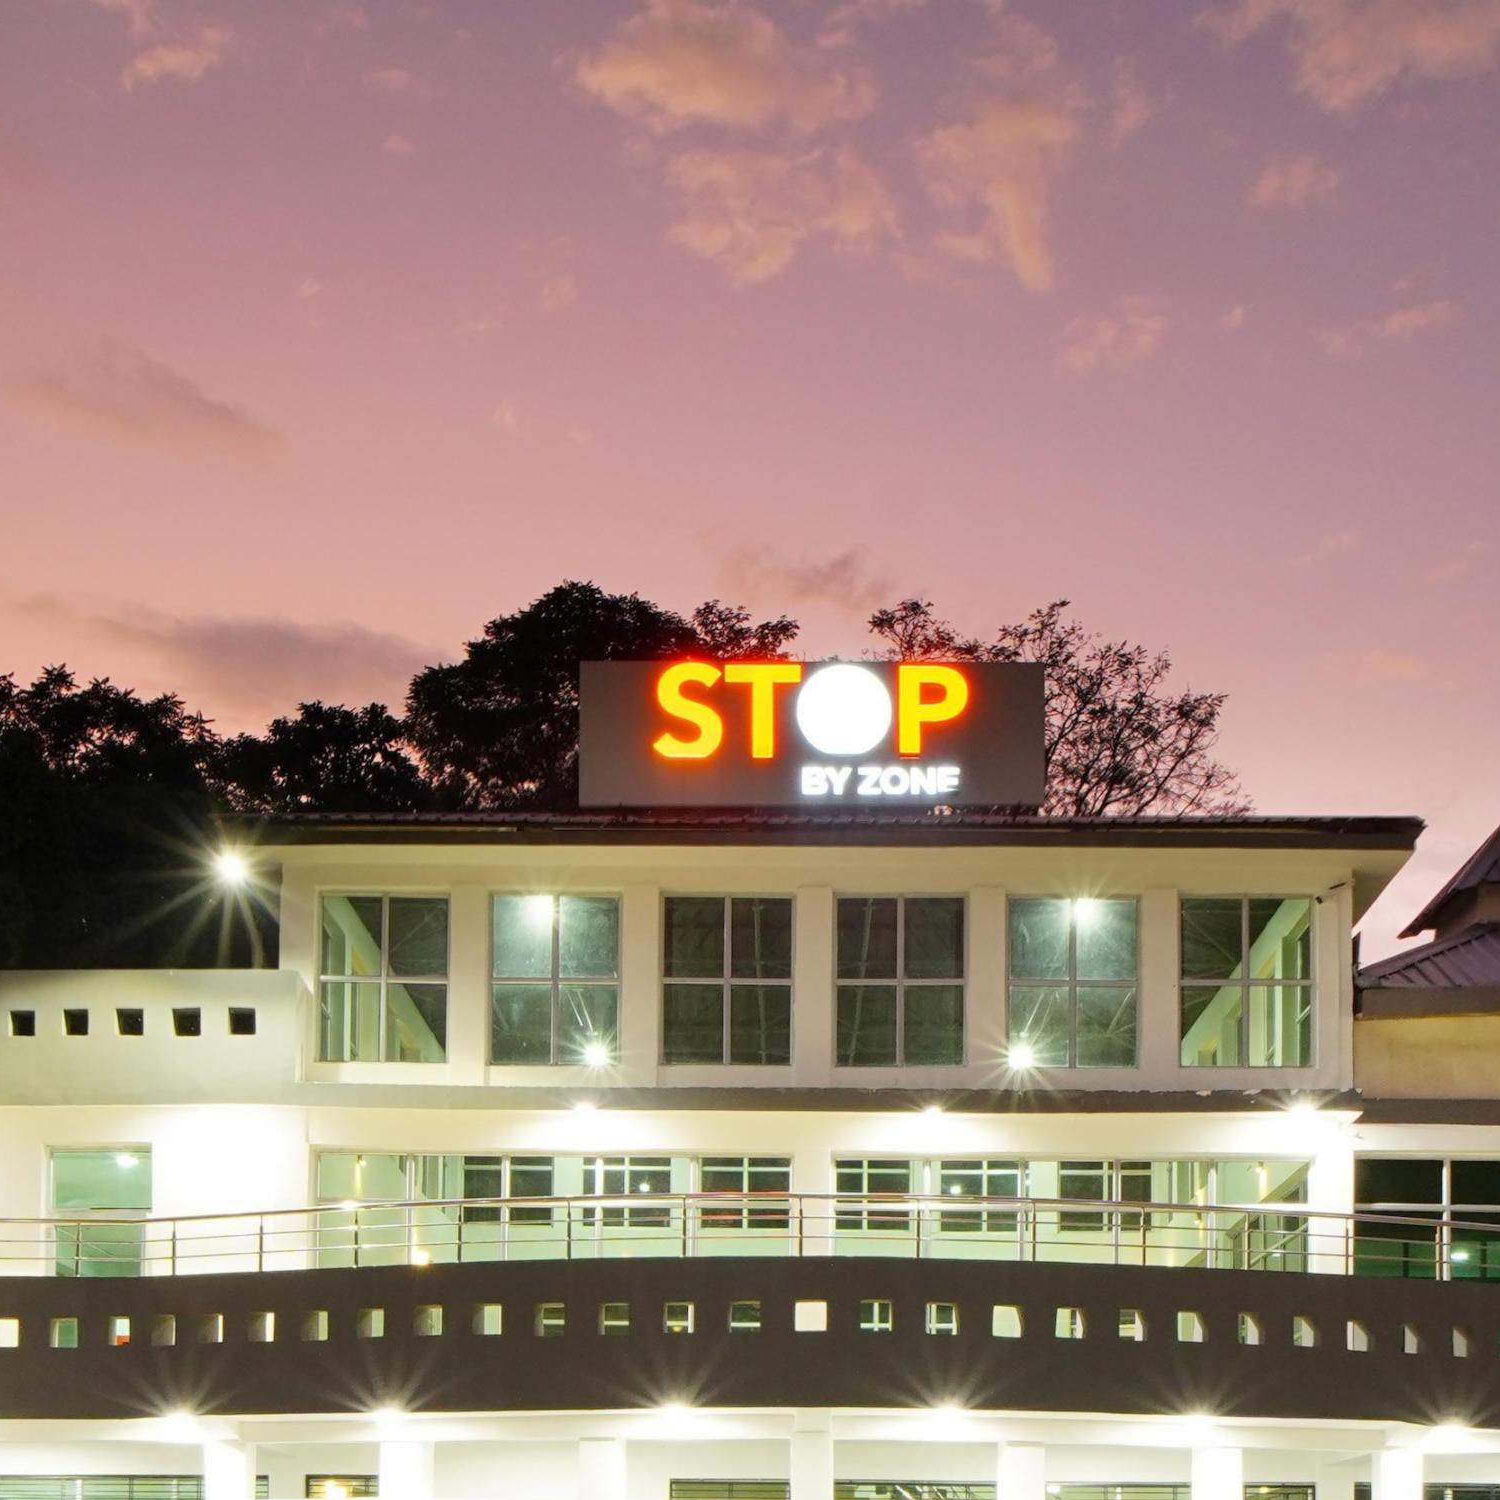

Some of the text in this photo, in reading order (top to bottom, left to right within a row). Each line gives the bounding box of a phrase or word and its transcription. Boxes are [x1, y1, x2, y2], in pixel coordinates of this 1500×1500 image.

[653, 662, 969, 759] STOP
[801, 766, 961, 796] BY ZONE
